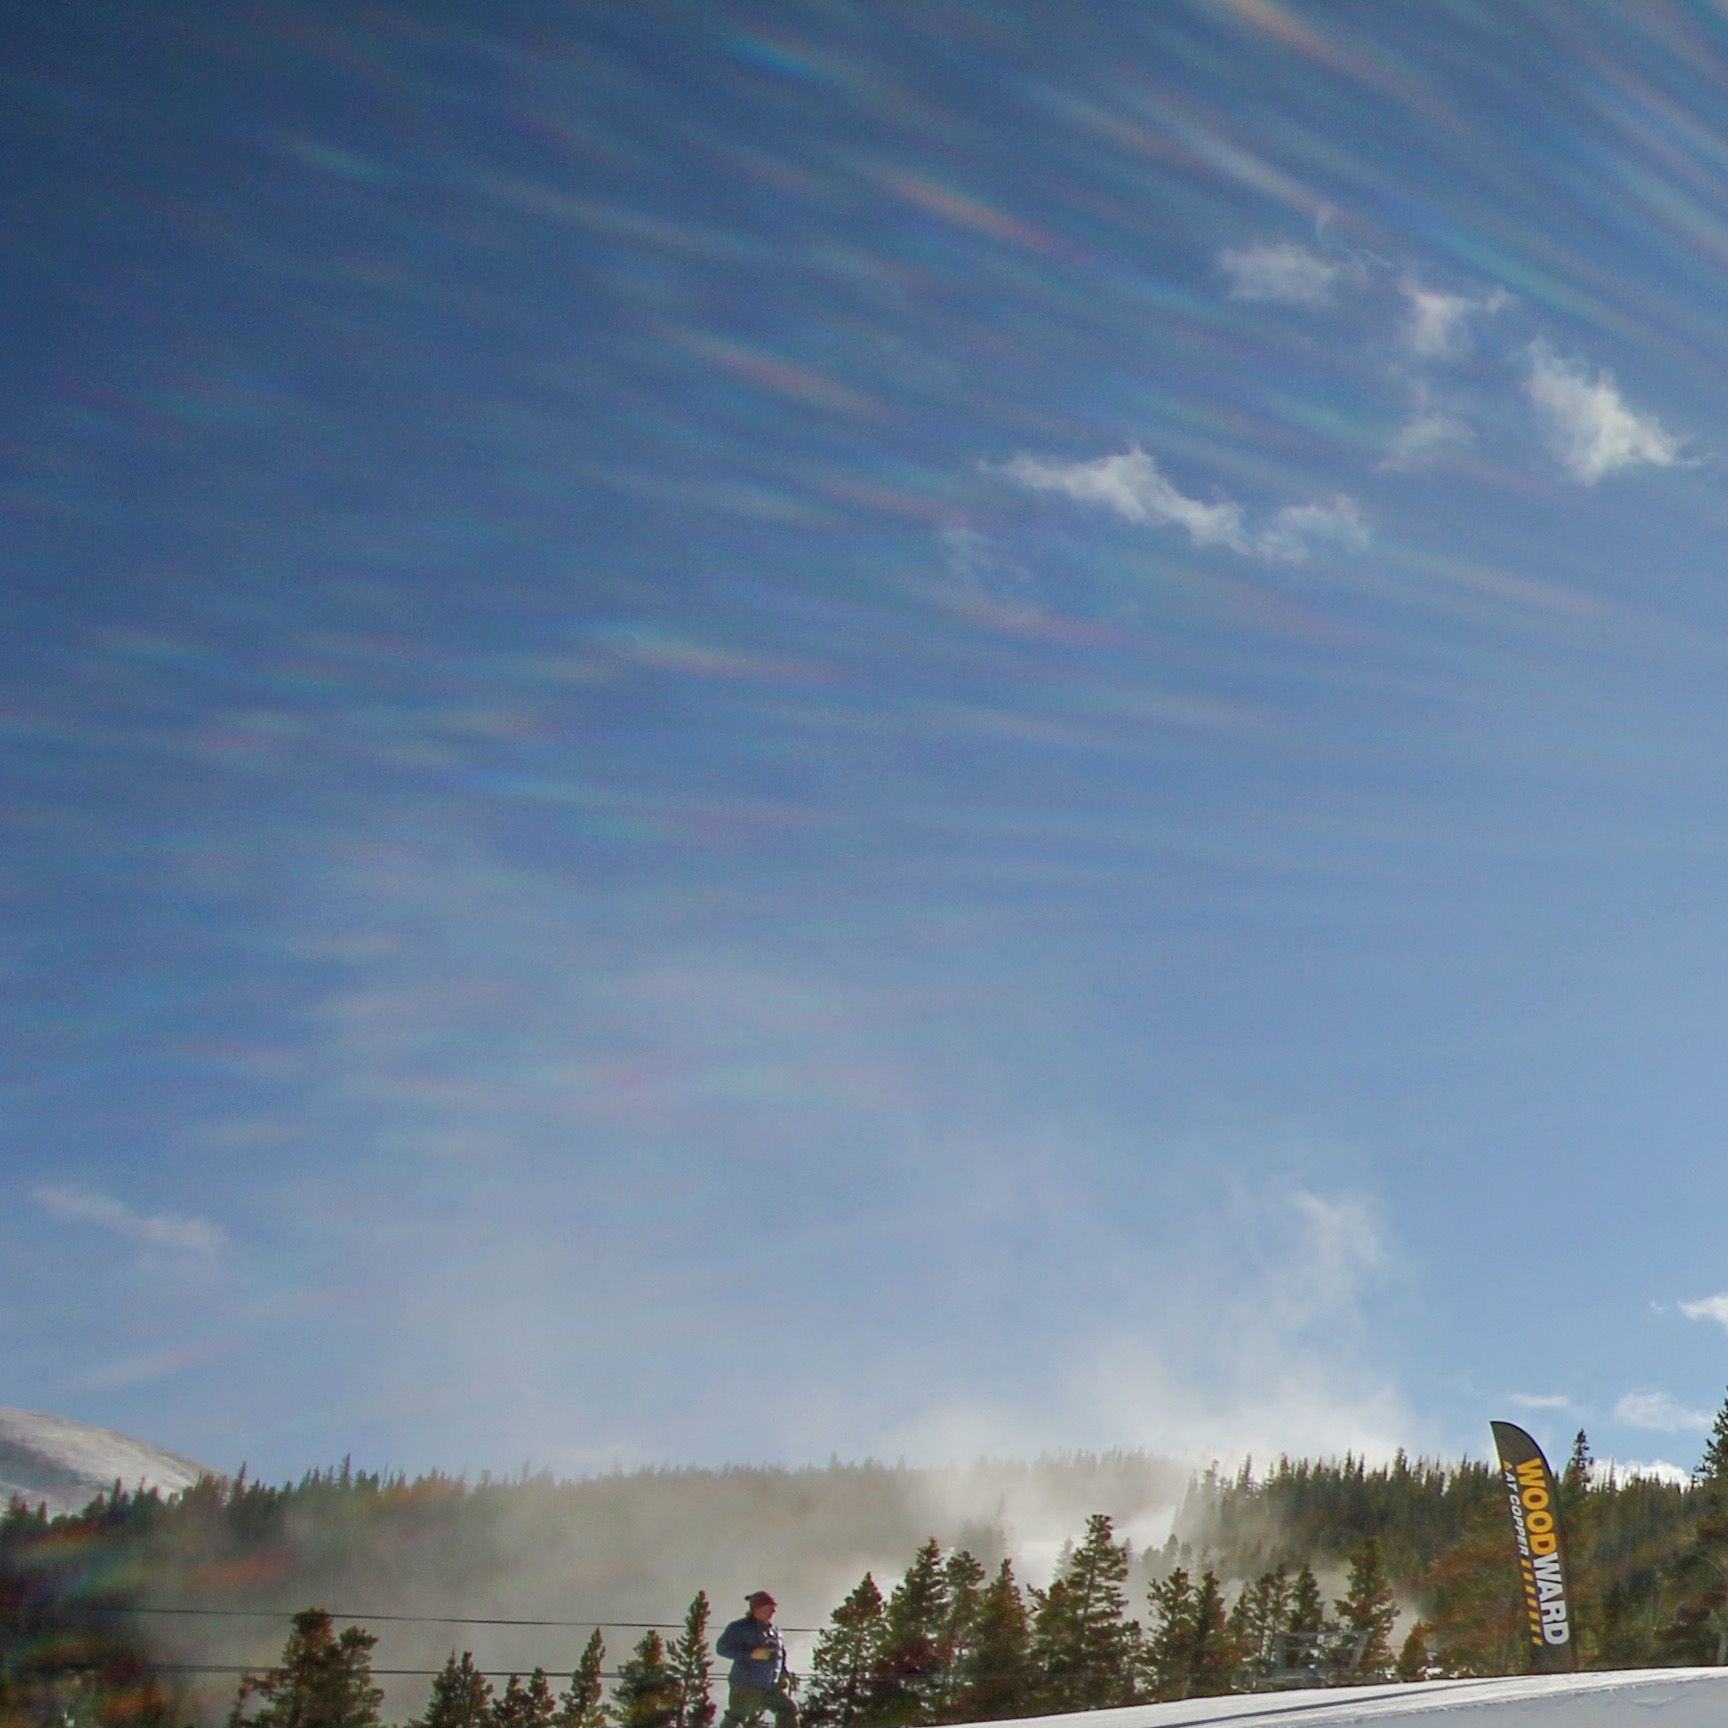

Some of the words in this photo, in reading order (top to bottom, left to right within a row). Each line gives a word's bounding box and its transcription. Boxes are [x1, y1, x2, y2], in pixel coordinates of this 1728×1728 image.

[1504, 1471, 1518, 1492] AT
[1510, 1494, 1530, 1556] COPPER
[1516, 1457, 1570, 1646] WOODWARD
